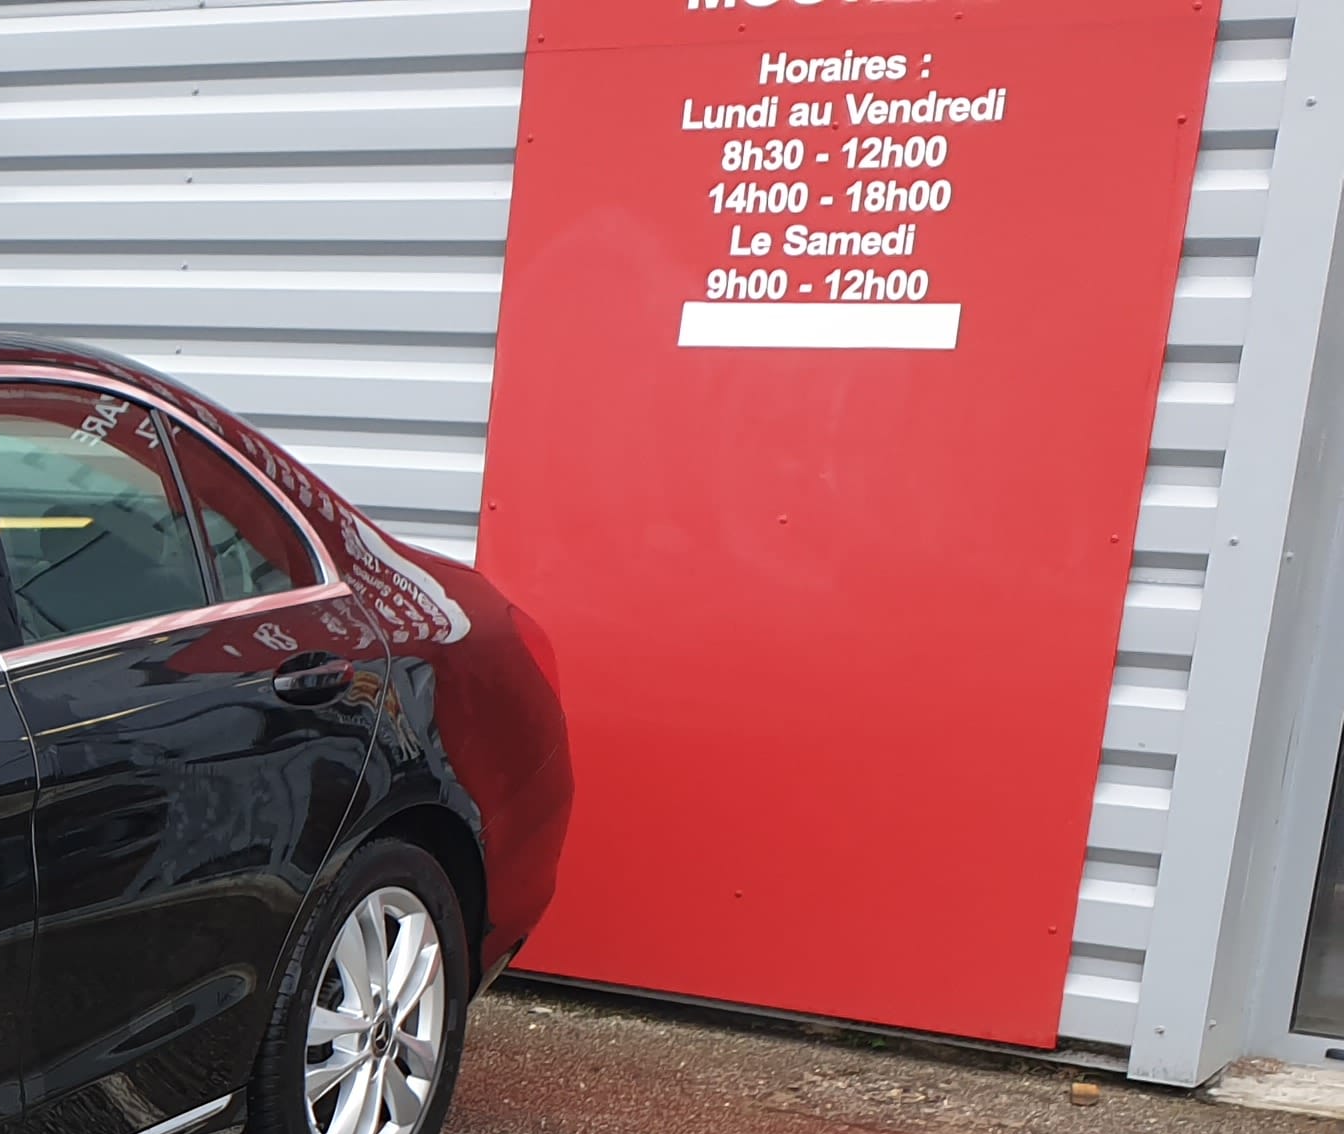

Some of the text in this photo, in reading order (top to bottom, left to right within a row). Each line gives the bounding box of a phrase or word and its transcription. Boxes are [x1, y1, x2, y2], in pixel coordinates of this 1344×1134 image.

[759, 49, 907, 84] Horaires
[681, 88, 1006, 130] Lundi au Vendredi
[721, 139, 805, 171] 8h30
[841, 135, 948, 170] 12h00
[708, 182, 809, 214] 14h00
[845, 179, 952, 213] 18h00
[729, 223, 917, 256] Le Samedi
[706, 268, 788, 300] 9h00
[824, 268, 929, 301] 12h00
